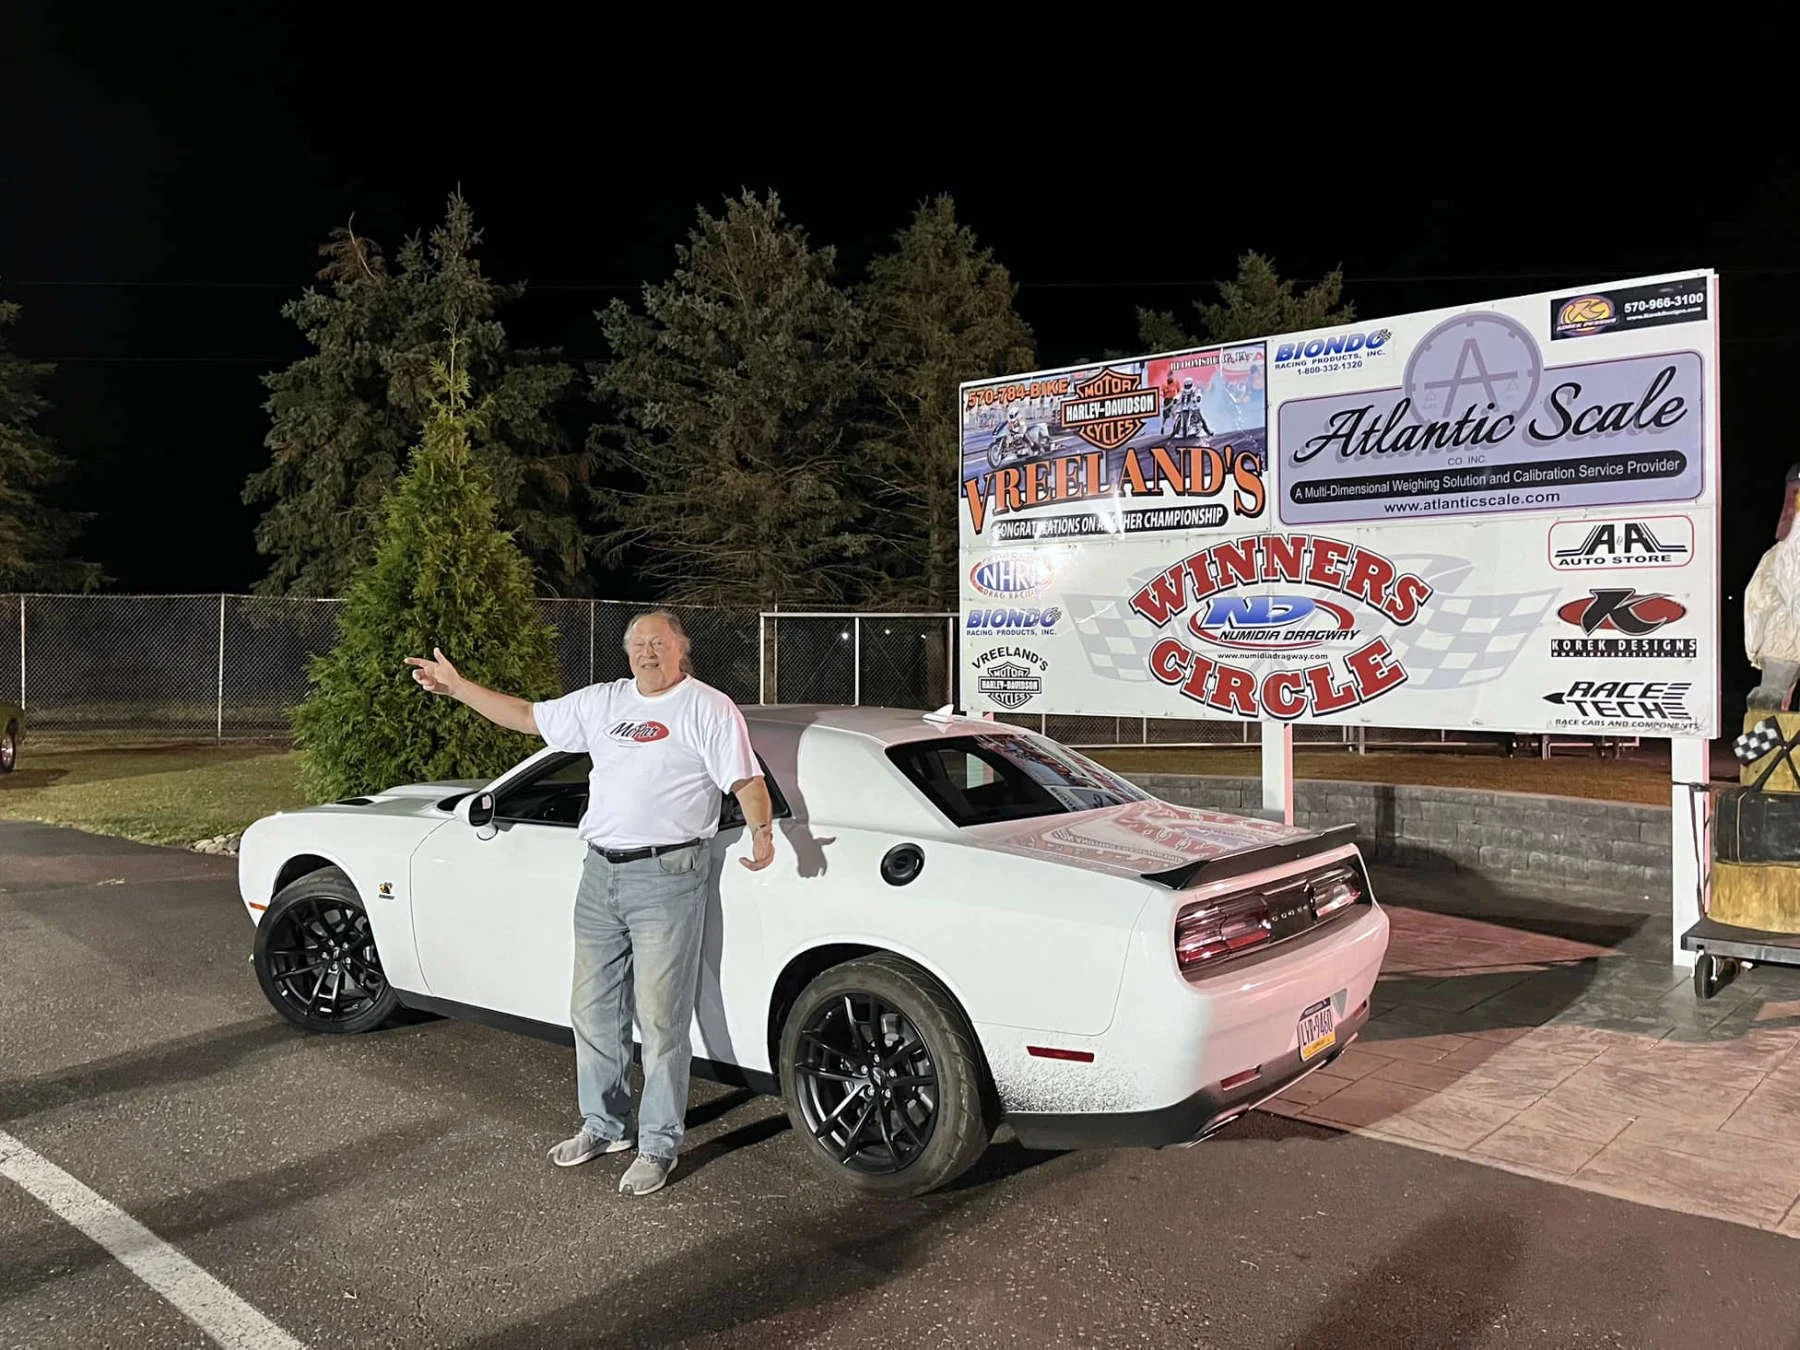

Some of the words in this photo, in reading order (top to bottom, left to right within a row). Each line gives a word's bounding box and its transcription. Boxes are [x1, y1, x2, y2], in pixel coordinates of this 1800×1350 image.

[1624, 293, 1704, 313] 570-966-3100
[1275, 328, 1392, 362] BIONDO
[1275, 360, 1307, 369] RACING
[1298, 361, 1363, 375] 1-800-332-1320
[967, 379, 1069, 408] 570-784-BIKE
[1085, 376, 1140, 397] MOTOR
[1065, 394, 1155, 421] HARLEY-DAVIDSON
[1293, 397, 1515, 463] Atlantic
[1529, 366, 1687, 440] Scale
[1085, 420, 1141, 445] CYCLES
[1294, 487, 1303, 499] A
[1304, 481, 1390, 499] Multi-Dimensional
[1392, 477, 1440, 493] Weighing
[1443, 473, 1487, 488] Solution
[1489, 471, 1511, 485] and
[1513, 467, 1575, 482] Calibration
[1578, 462, 1624, 477] Service
[1627, 458, 1680, 474] Provider
[964, 446, 1265, 535] VREELAND'S
[1384, 492, 1561, 513] www.atlanticscale.com
[994, 516, 1081, 539] ONGRATATIONS
[1082, 518, 1096, 533] ON
[1098, 513, 1143, 532] AHER
[1144, 506, 1224, 528] CHAMPIONSHIP
[1558, 557, 1606, 566] AUTO
[1612, 555, 1673, 564] STORE
[983, 560, 1044, 591] NHR
[1129, 534, 1434, 628] WINNERS
[967, 607, 1062, 629] BIONDO
[1219, 630, 1281, 642] NUMIDIA
[1283, 629, 1361, 641] DRAGWAY
[1552, 640, 1607, 651] KOREK
[1618, 640, 1697, 651] DESIGNS
[972, 646, 1049, 672] VREELAND'S
[1217, 652, 1329, 661] www.numidiadragway.com
[1150, 635, 1408, 719] CIRCLE
[1566, 681, 1668, 699] RACE
[1566, 700, 1668, 719] TECH
[1555, 719, 1579, 727] RACE
[1582, 719, 1606, 727] CARS
